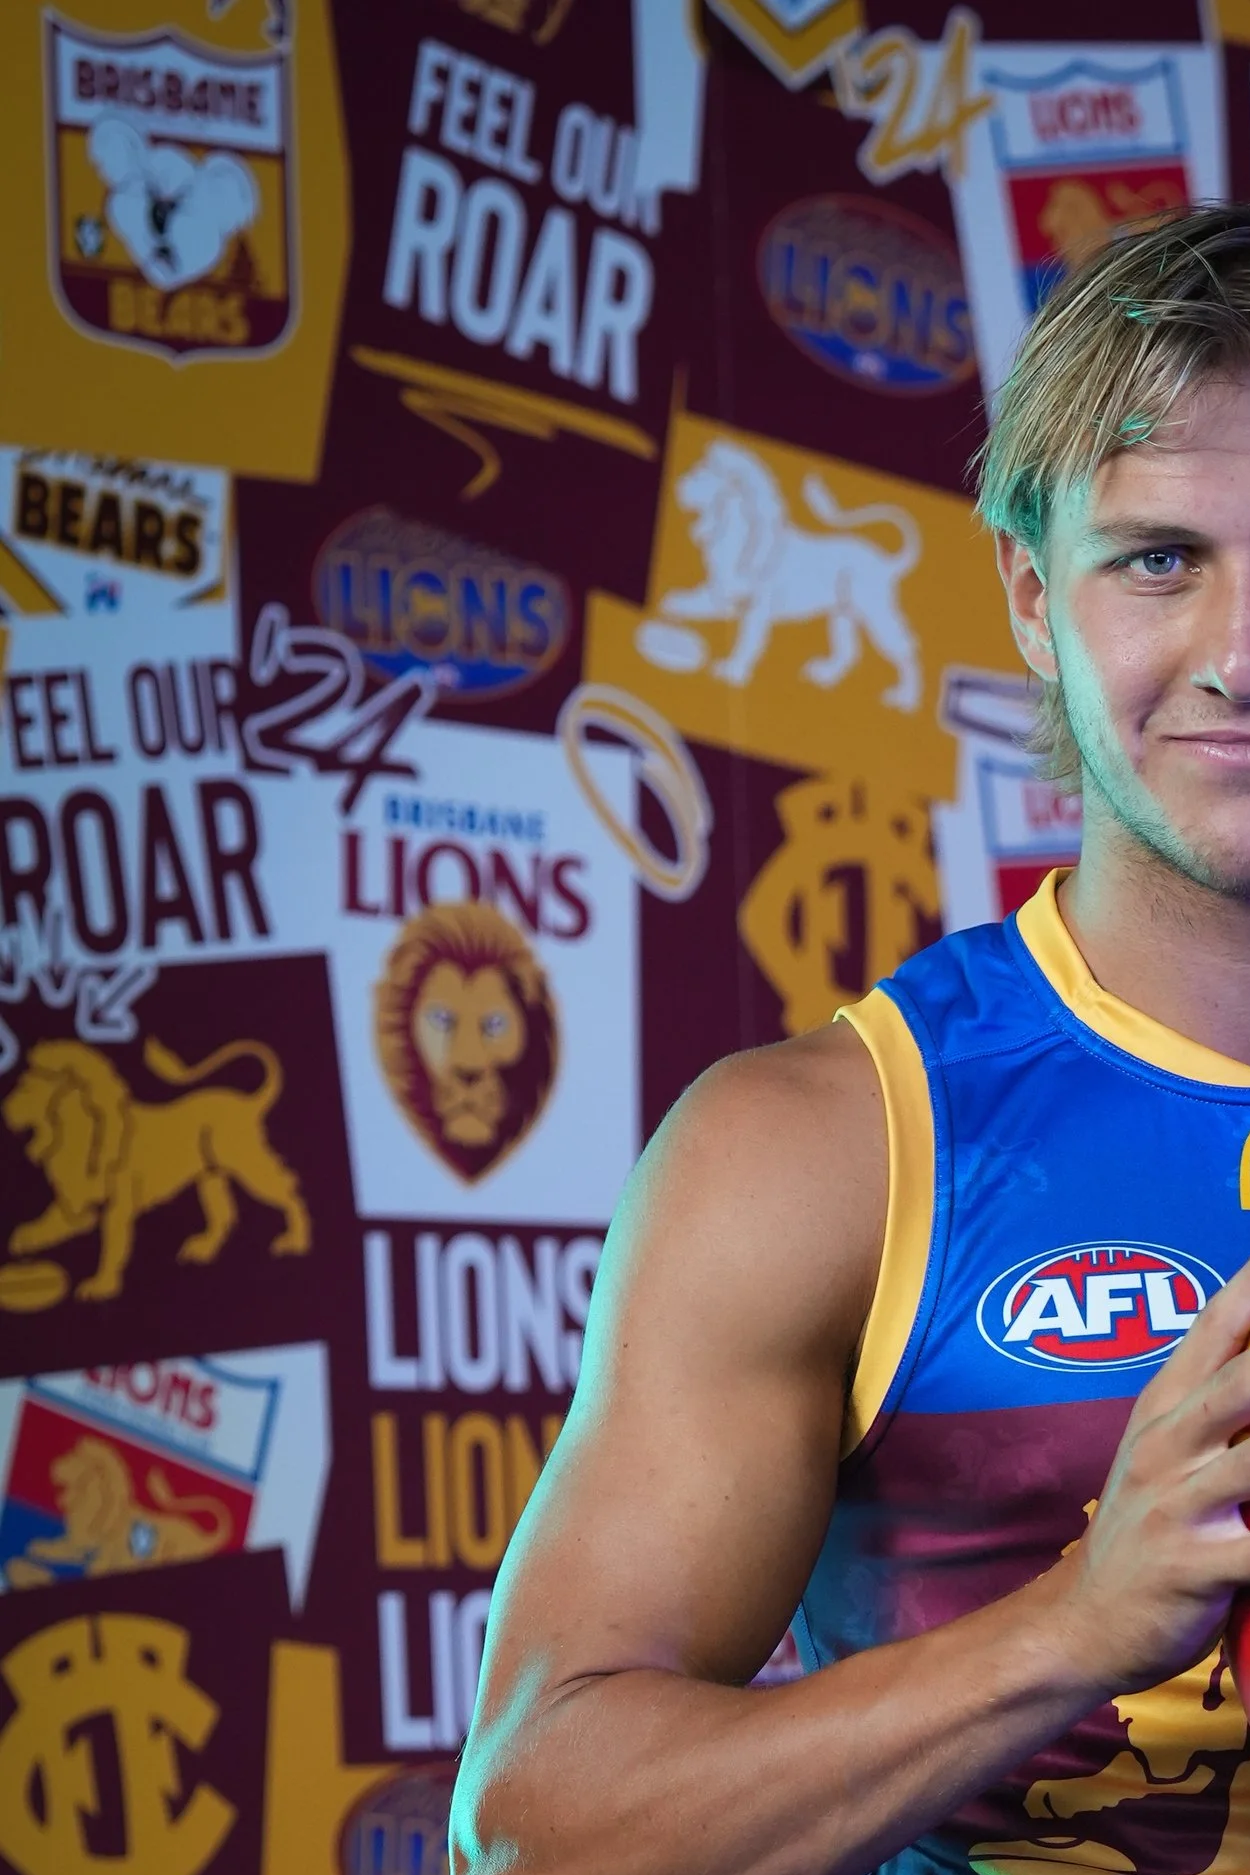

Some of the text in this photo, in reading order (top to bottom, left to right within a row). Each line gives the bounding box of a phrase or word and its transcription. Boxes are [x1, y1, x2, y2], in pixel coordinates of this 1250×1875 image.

[74, 56, 265, 127] BRISBANE
[408, 38, 541, 186] FEEL
[108, 277, 250, 346] BEARS
[383, 145, 656, 404] ROAR
[17, 472, 204, 580] BEARS
[320, 560, 552, 670] LIONS
[383, 795, 547, 842] BRISBANE
[340, 830, 592, 942] LIONS
[1003, 1272, 1205, 1342] AFL
